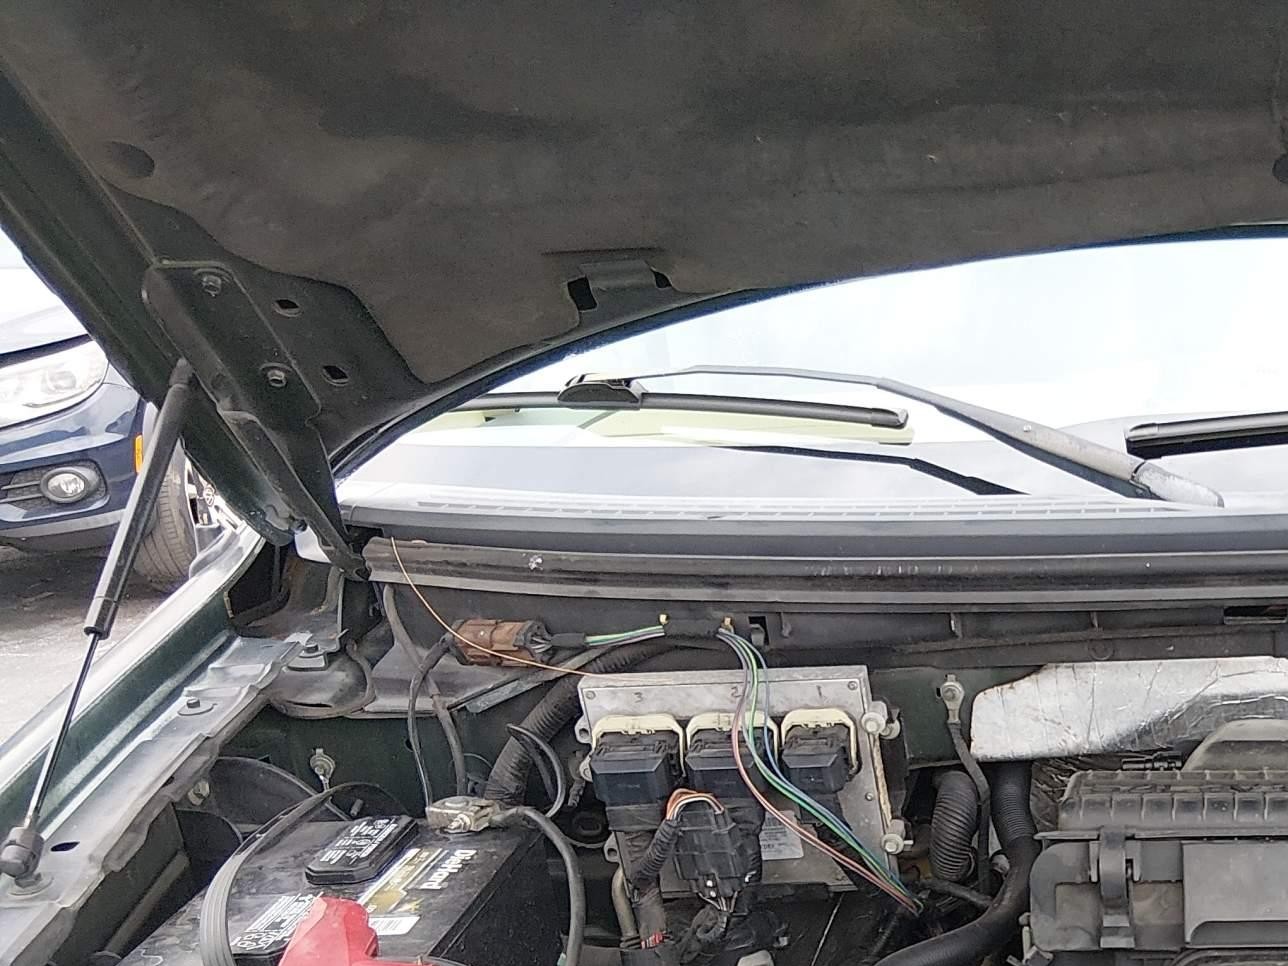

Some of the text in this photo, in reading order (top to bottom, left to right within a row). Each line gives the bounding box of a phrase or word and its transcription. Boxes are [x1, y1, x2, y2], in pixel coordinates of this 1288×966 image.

[634, 691, 643, 703] 3
[731, 686, 741, 698] 2
[420, 849, 478, 889] DieHard
